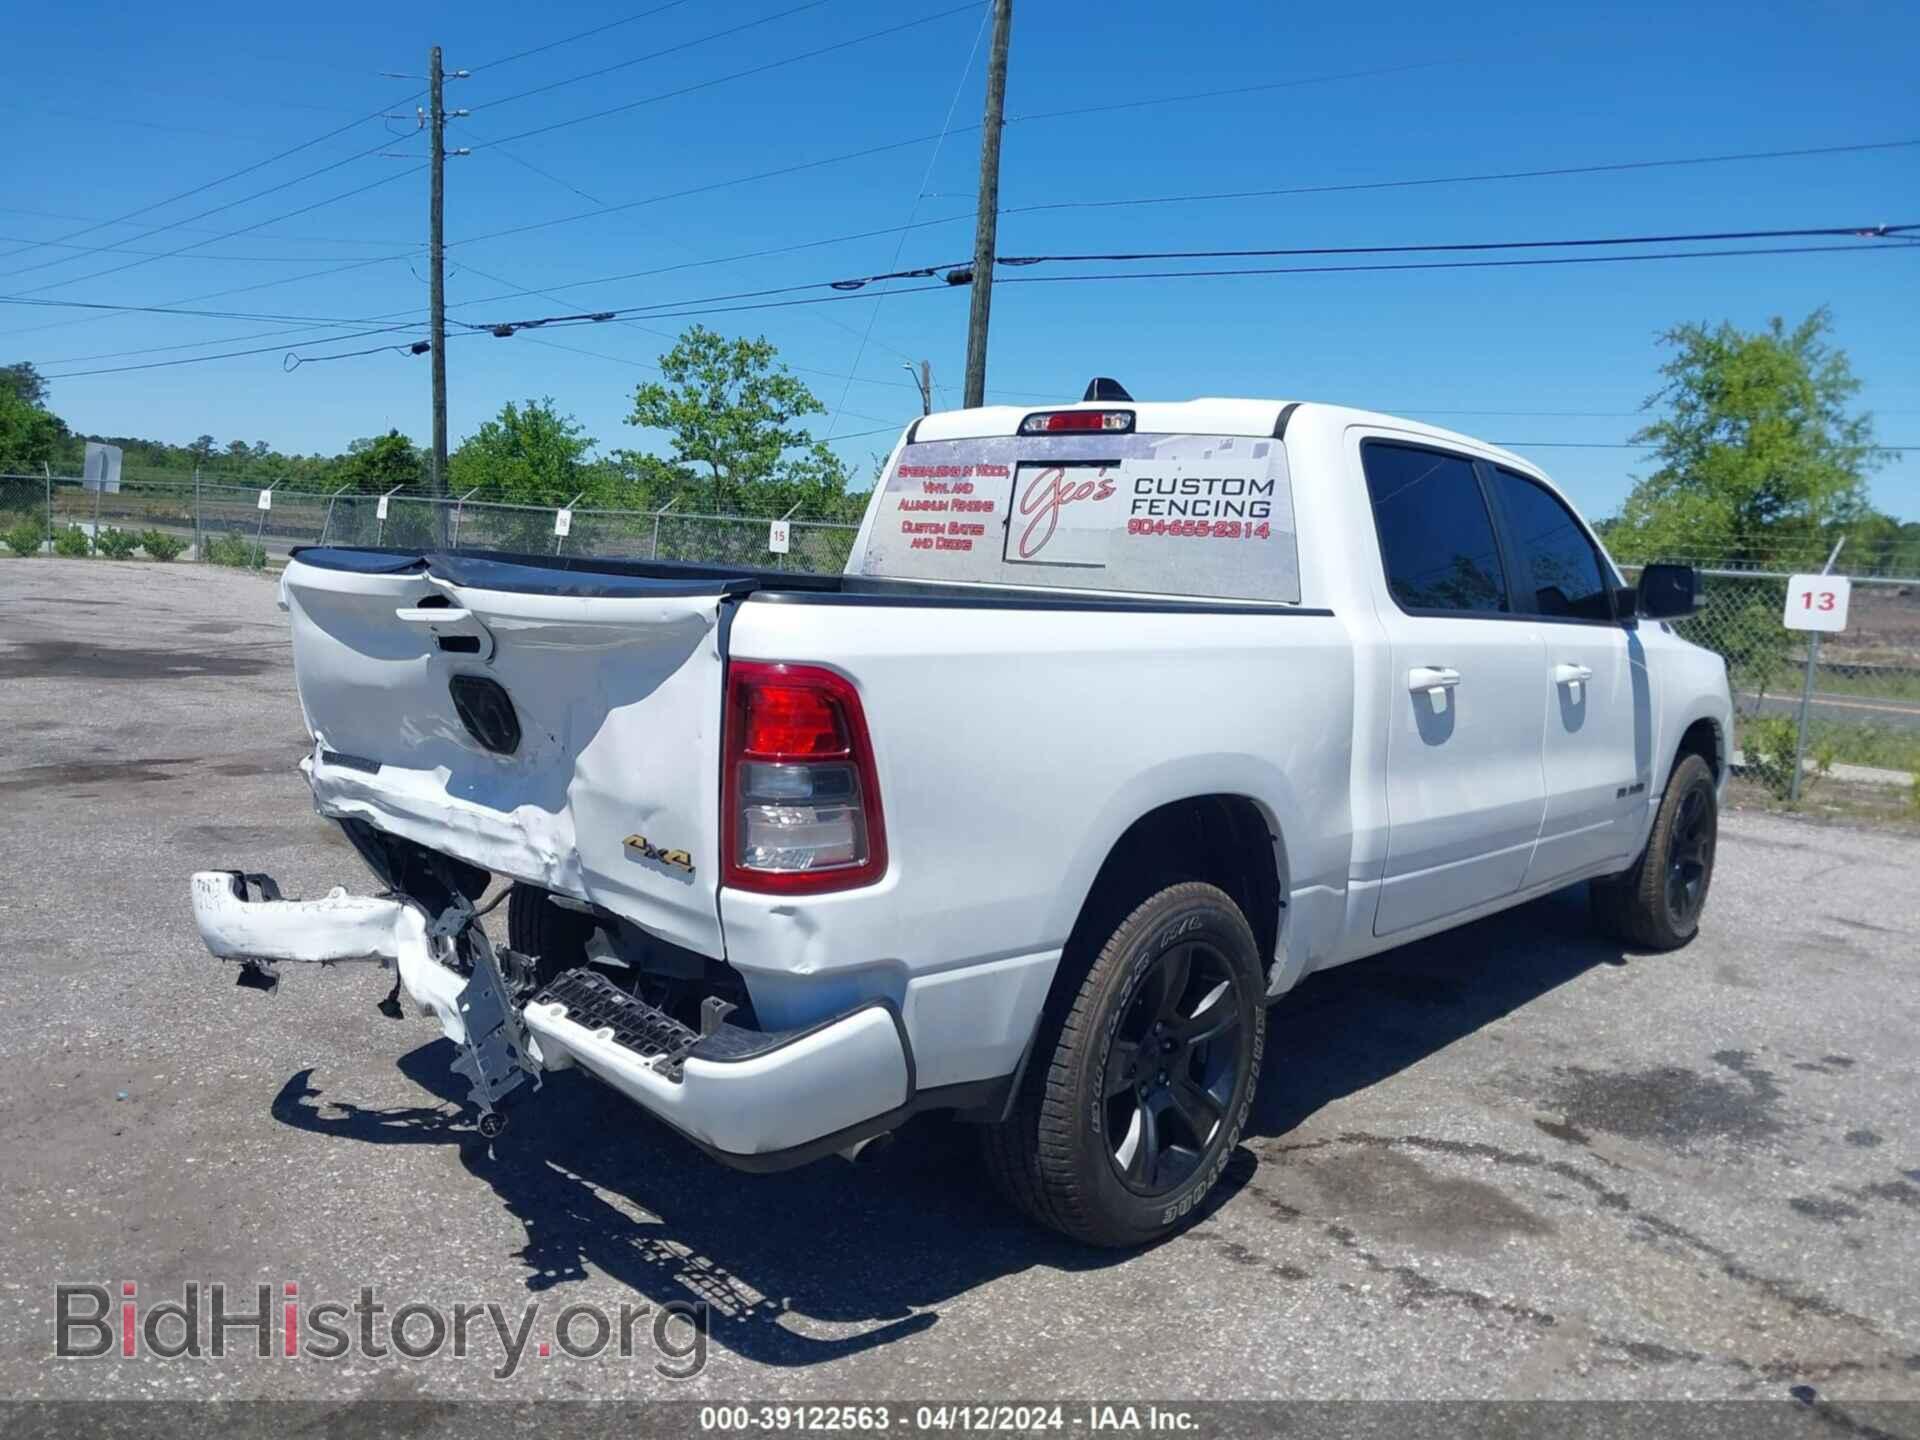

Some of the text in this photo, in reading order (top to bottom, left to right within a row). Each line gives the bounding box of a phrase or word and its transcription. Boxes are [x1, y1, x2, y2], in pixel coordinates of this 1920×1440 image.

[1134, 477, 1276, 496] CUSTOM
[1130, 498, 1273, 518] FENCING
[774, 530, 785, 542] 15
[1127, 518, 1271, 540] 904-655-2314
[1801, 591, 1836, 611] 13
